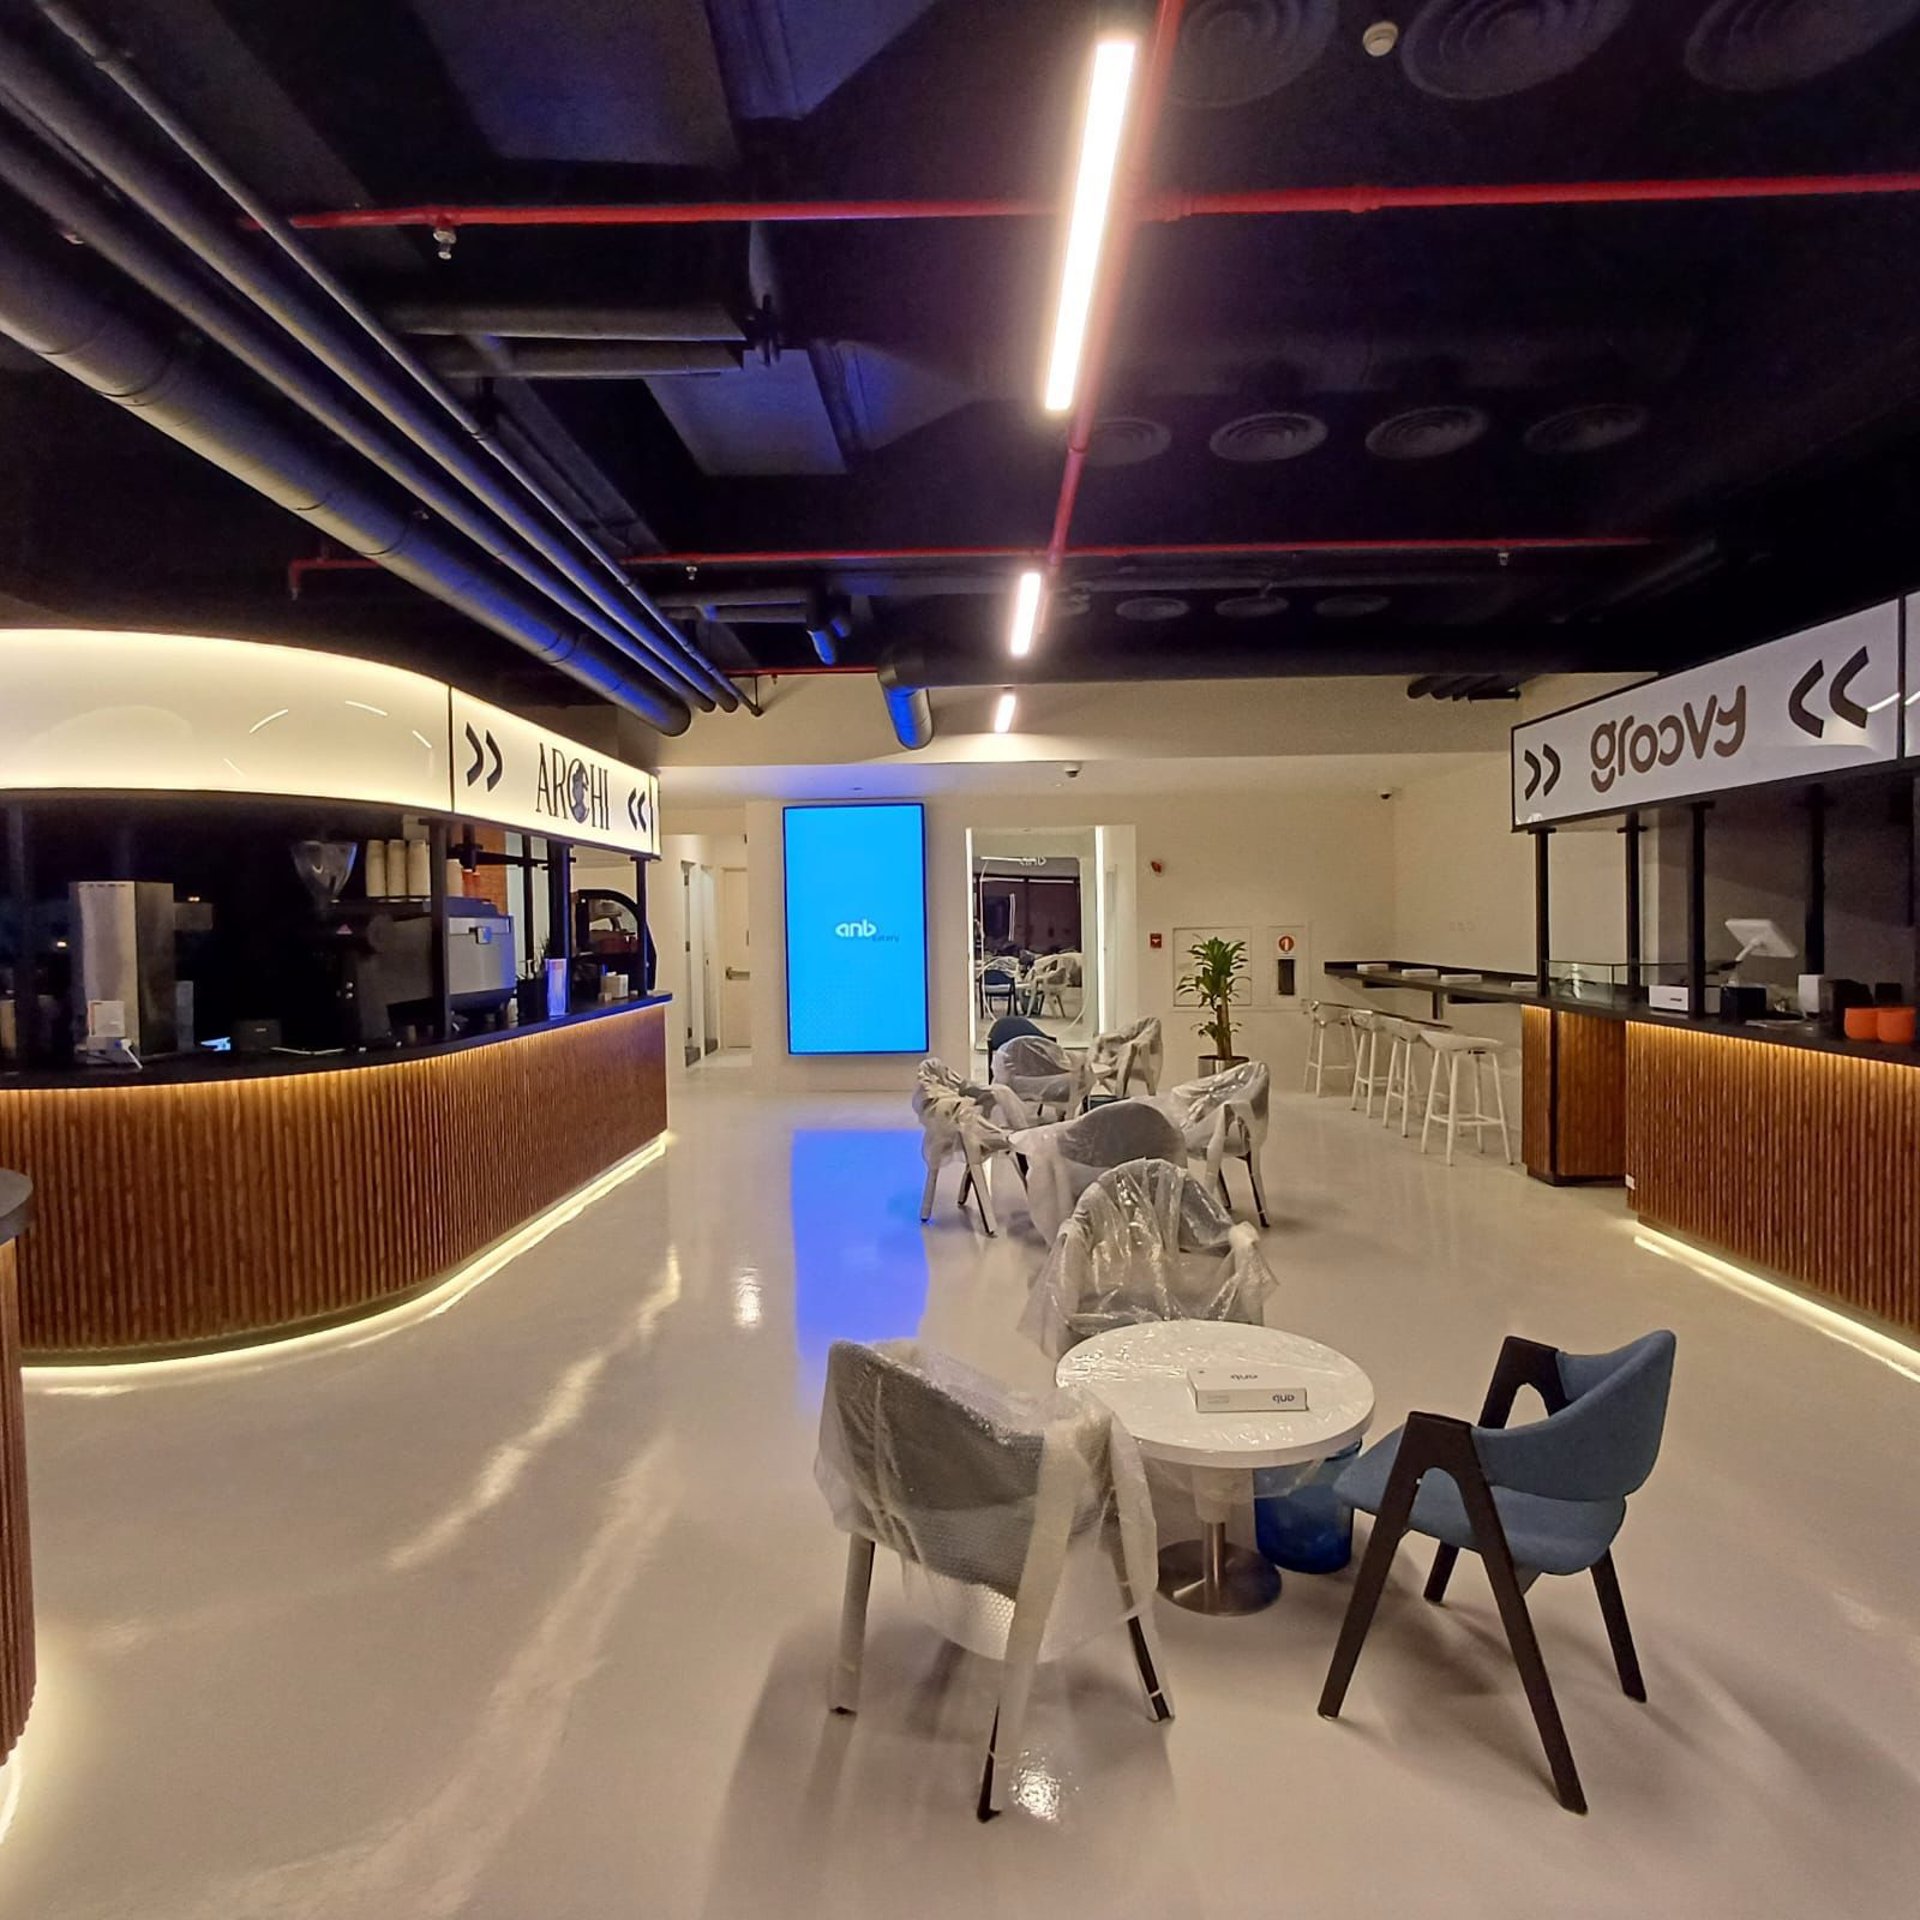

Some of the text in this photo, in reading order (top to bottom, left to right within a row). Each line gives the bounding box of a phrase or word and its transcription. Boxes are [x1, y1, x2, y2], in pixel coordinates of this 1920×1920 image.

[1590, 684, 1747, 793] groovy
[536, 742, 610, 831] ARCHI
[835, 919, 877, 938] anb
[1272, 1393, 1295, 1404] anb
